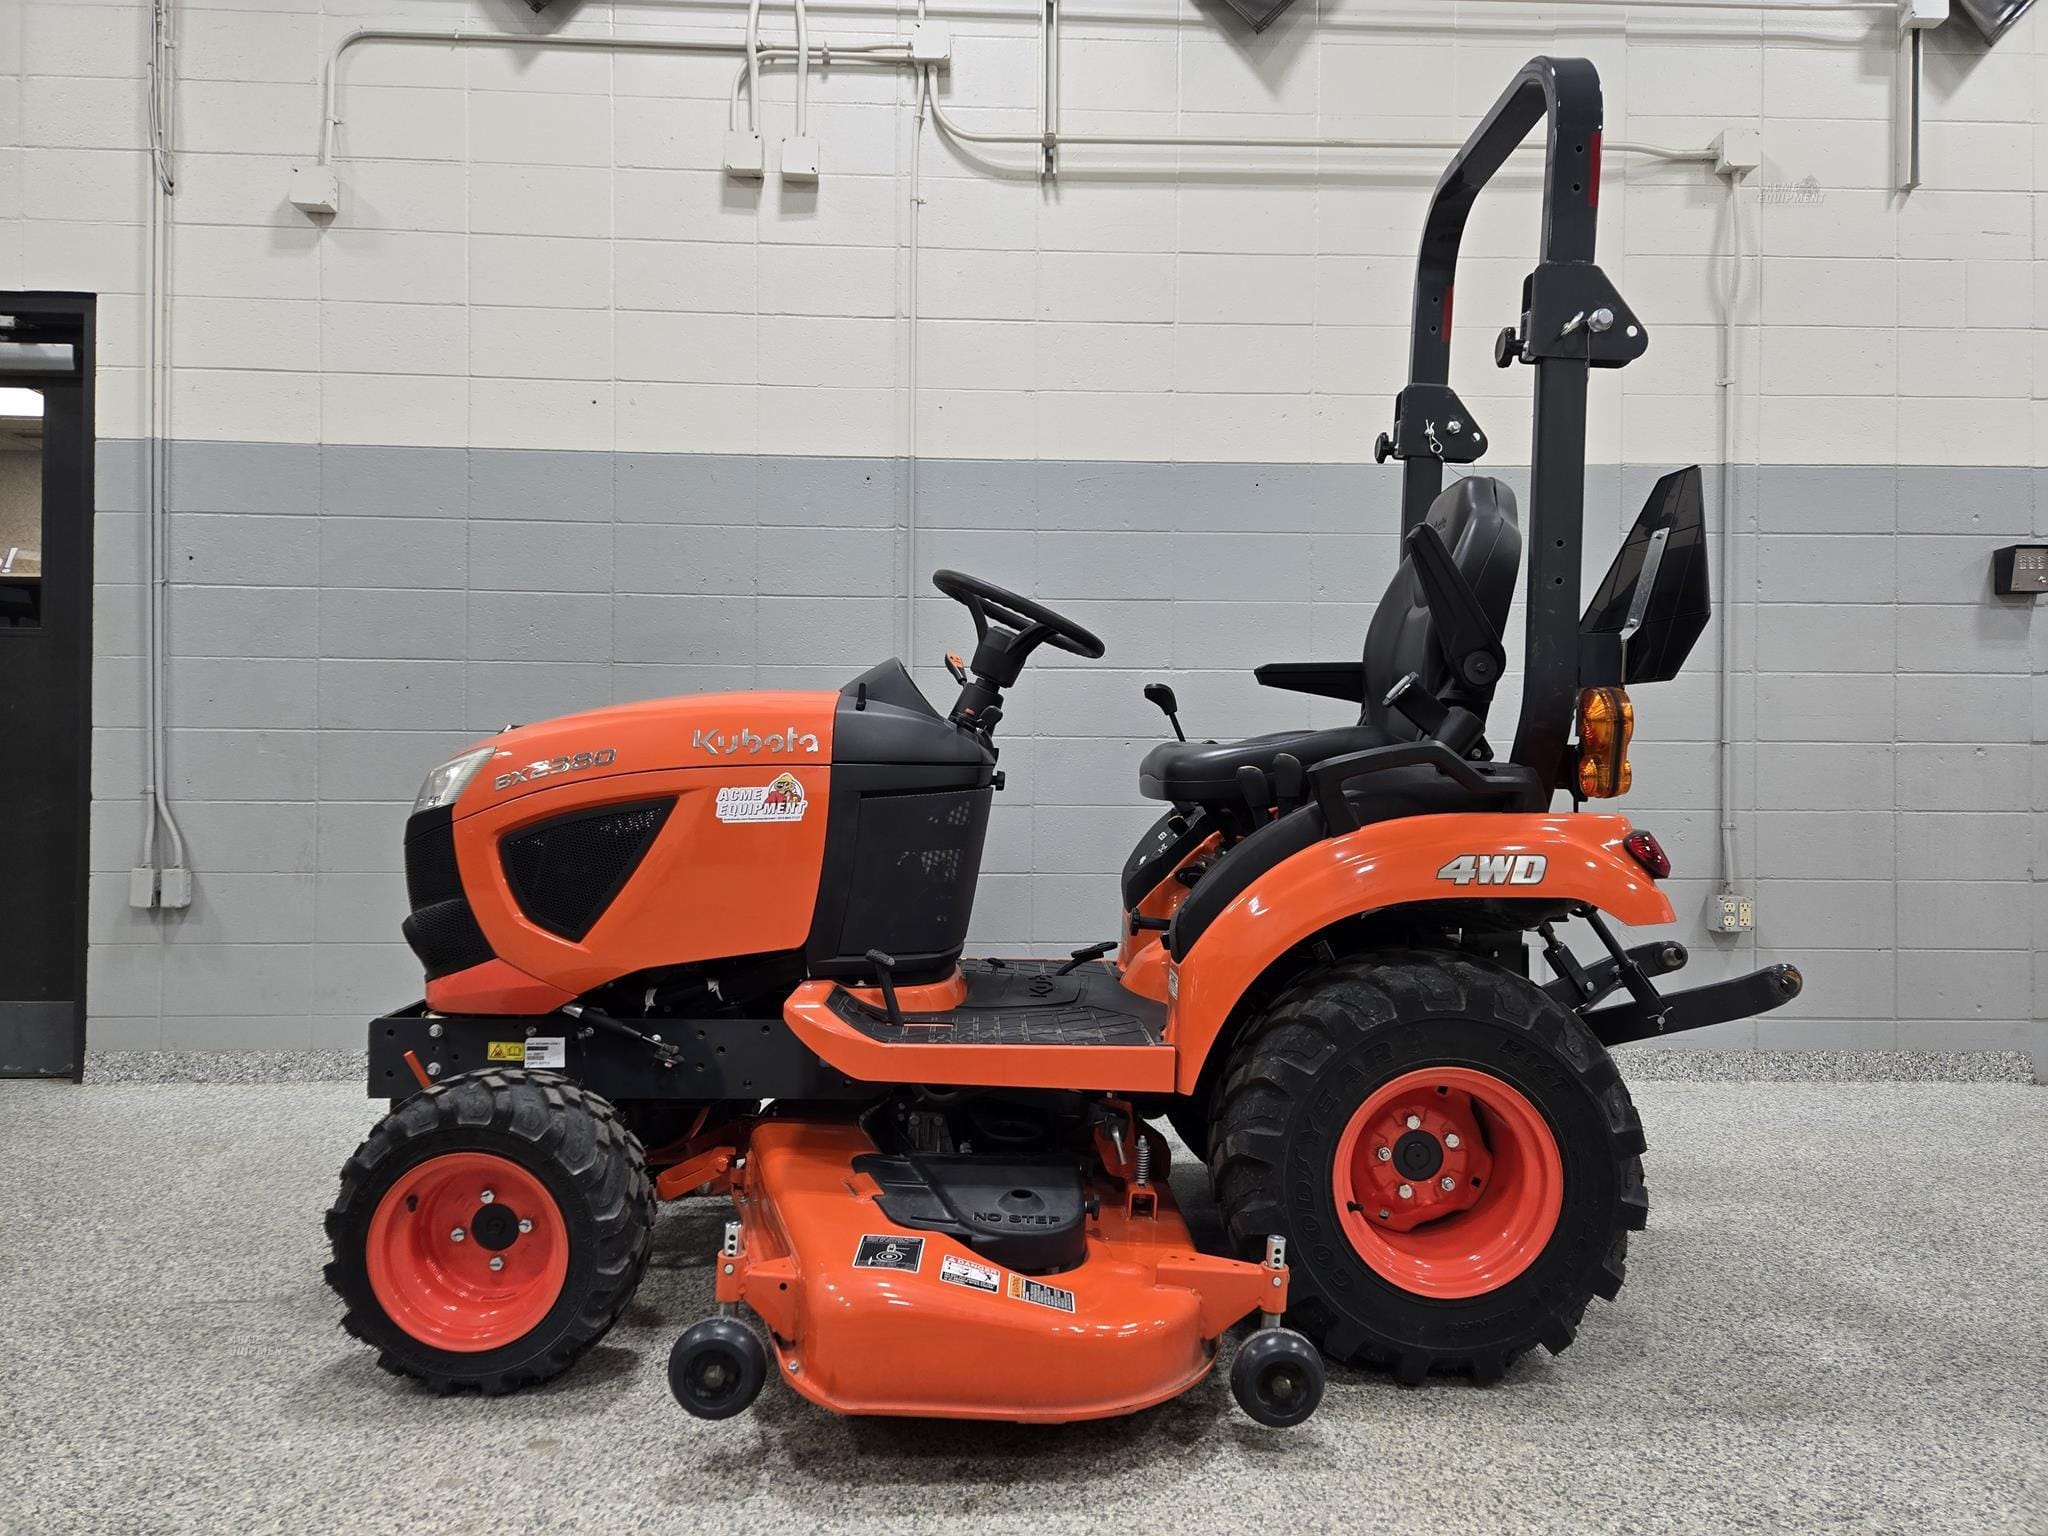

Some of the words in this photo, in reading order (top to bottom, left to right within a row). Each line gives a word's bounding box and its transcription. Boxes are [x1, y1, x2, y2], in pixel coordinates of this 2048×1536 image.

[692, 727, 819, 755] Kubota
[494, 748, 617, 791] BX2380
[719, 788, 763, 802] ACME
[718, 801, 806, 817] EQUIPMENT
[1436, 854, 1548, 885] 4WD
[1294, 1040, 1394, 1294] GOODYEAR
[972, 1211, 1002, 1223] NO
[1008, 1214, 1061, 1225] STEP
[957, 1258, 998, 1275] DANGER
